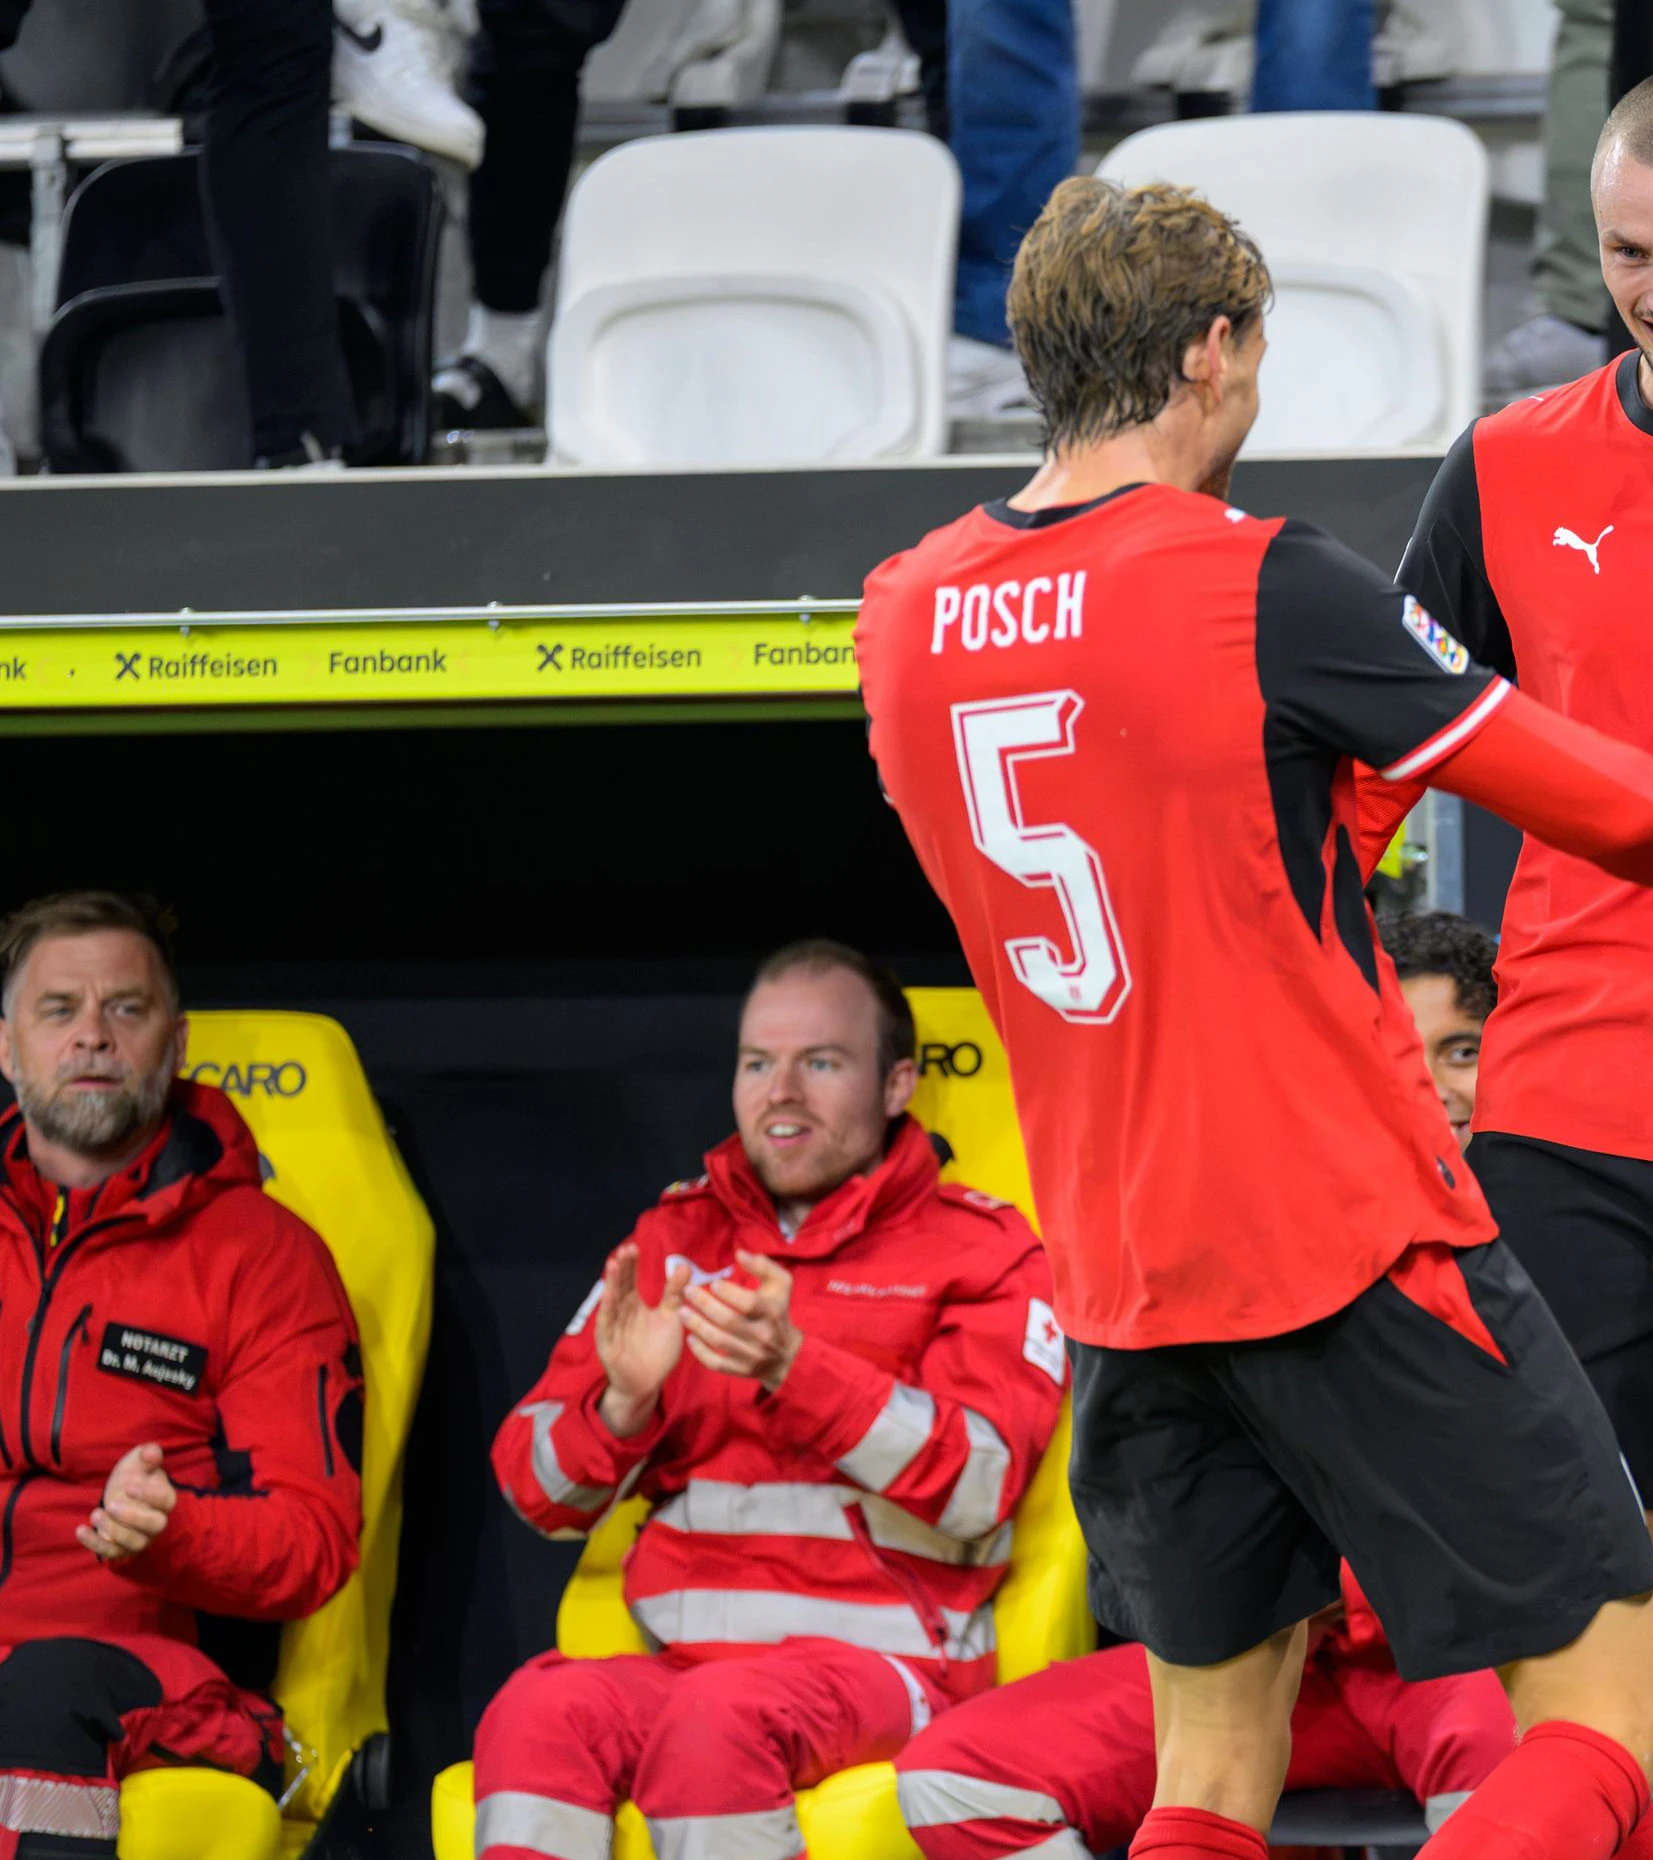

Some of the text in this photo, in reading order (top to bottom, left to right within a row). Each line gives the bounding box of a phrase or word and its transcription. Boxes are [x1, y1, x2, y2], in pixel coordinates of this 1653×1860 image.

[931, 570, 1087, 654] POSCH
[149, 653, 278, 679] Raiffeisen
[329, 648, 447, 674] Fanbank
[571, 643, 702, 669] Raiffeisen
[950, 689, 1132, 1024] 5
